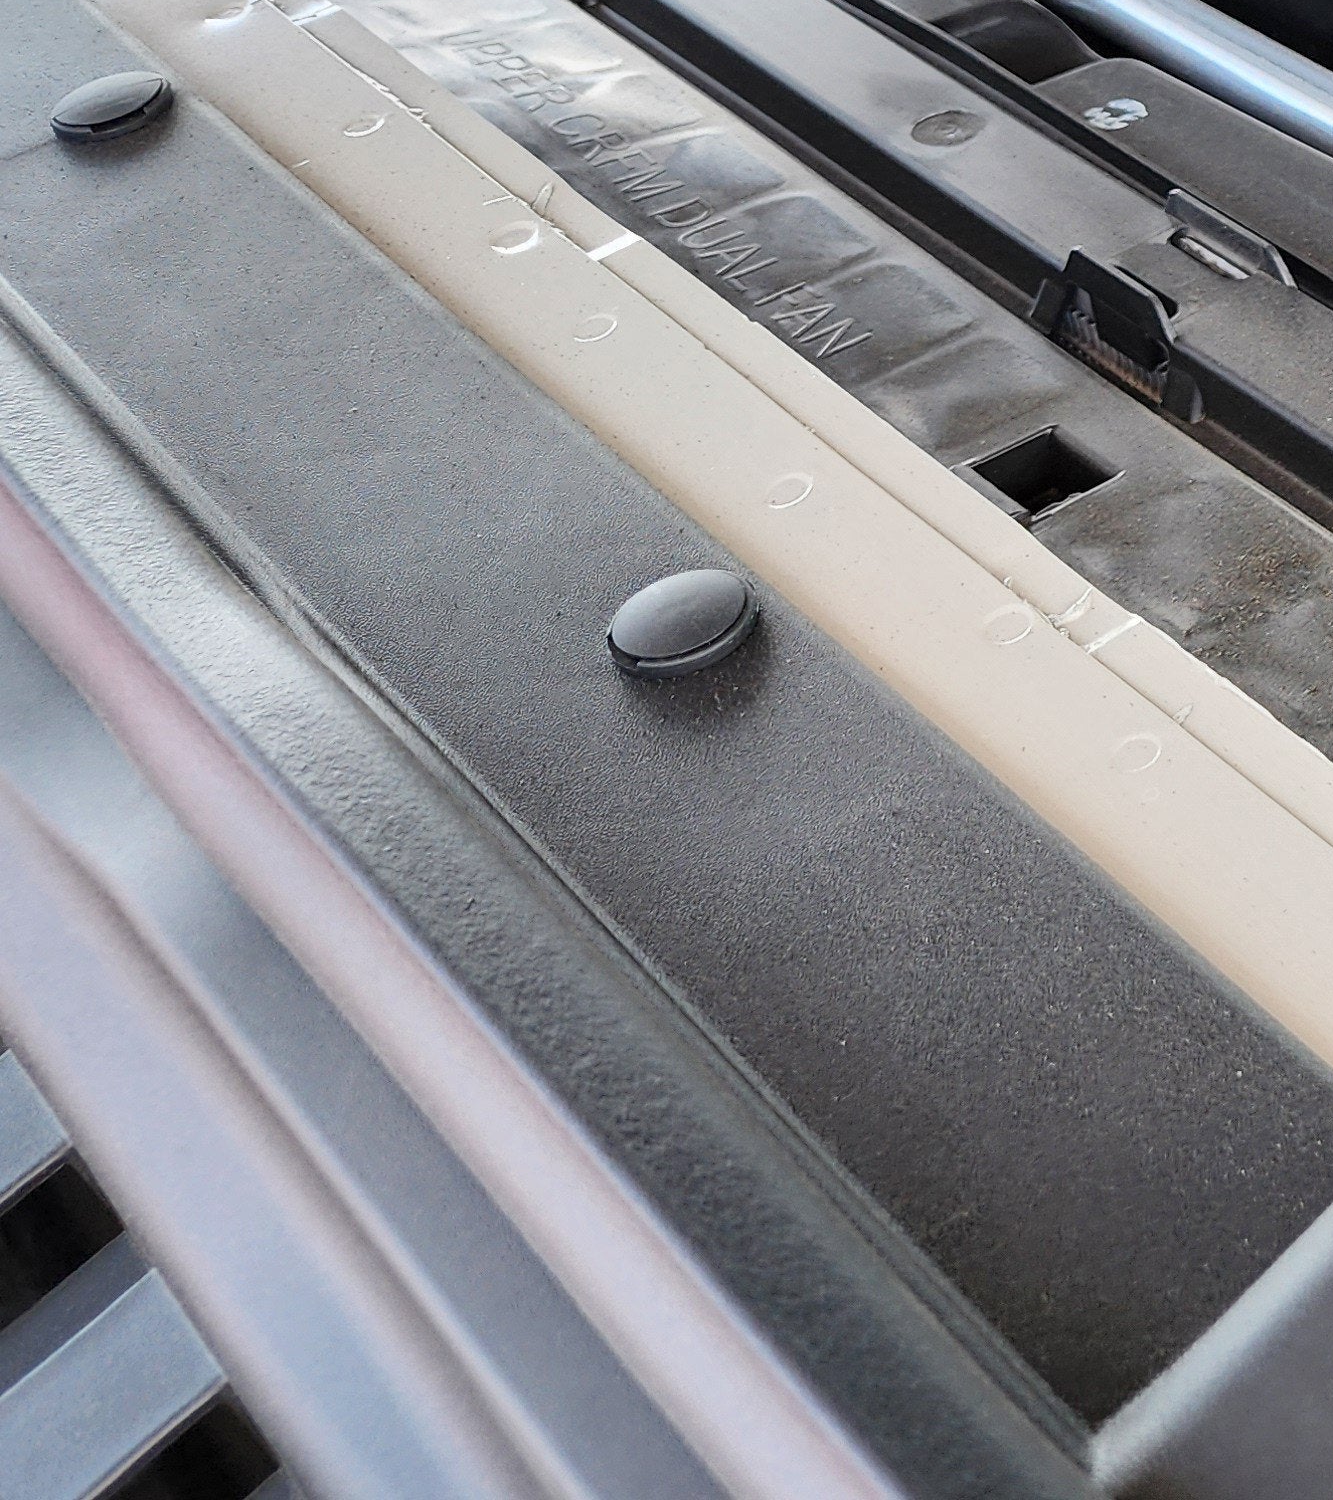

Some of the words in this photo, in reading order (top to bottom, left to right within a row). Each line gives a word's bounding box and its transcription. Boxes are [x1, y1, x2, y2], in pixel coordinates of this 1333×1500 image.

[439, 30, 575, 112] UPPER
[548, 112, 685, 202] CRFM
[648, 197, 779, 292] DUAL
[754, 280, 874, 359] FAN
